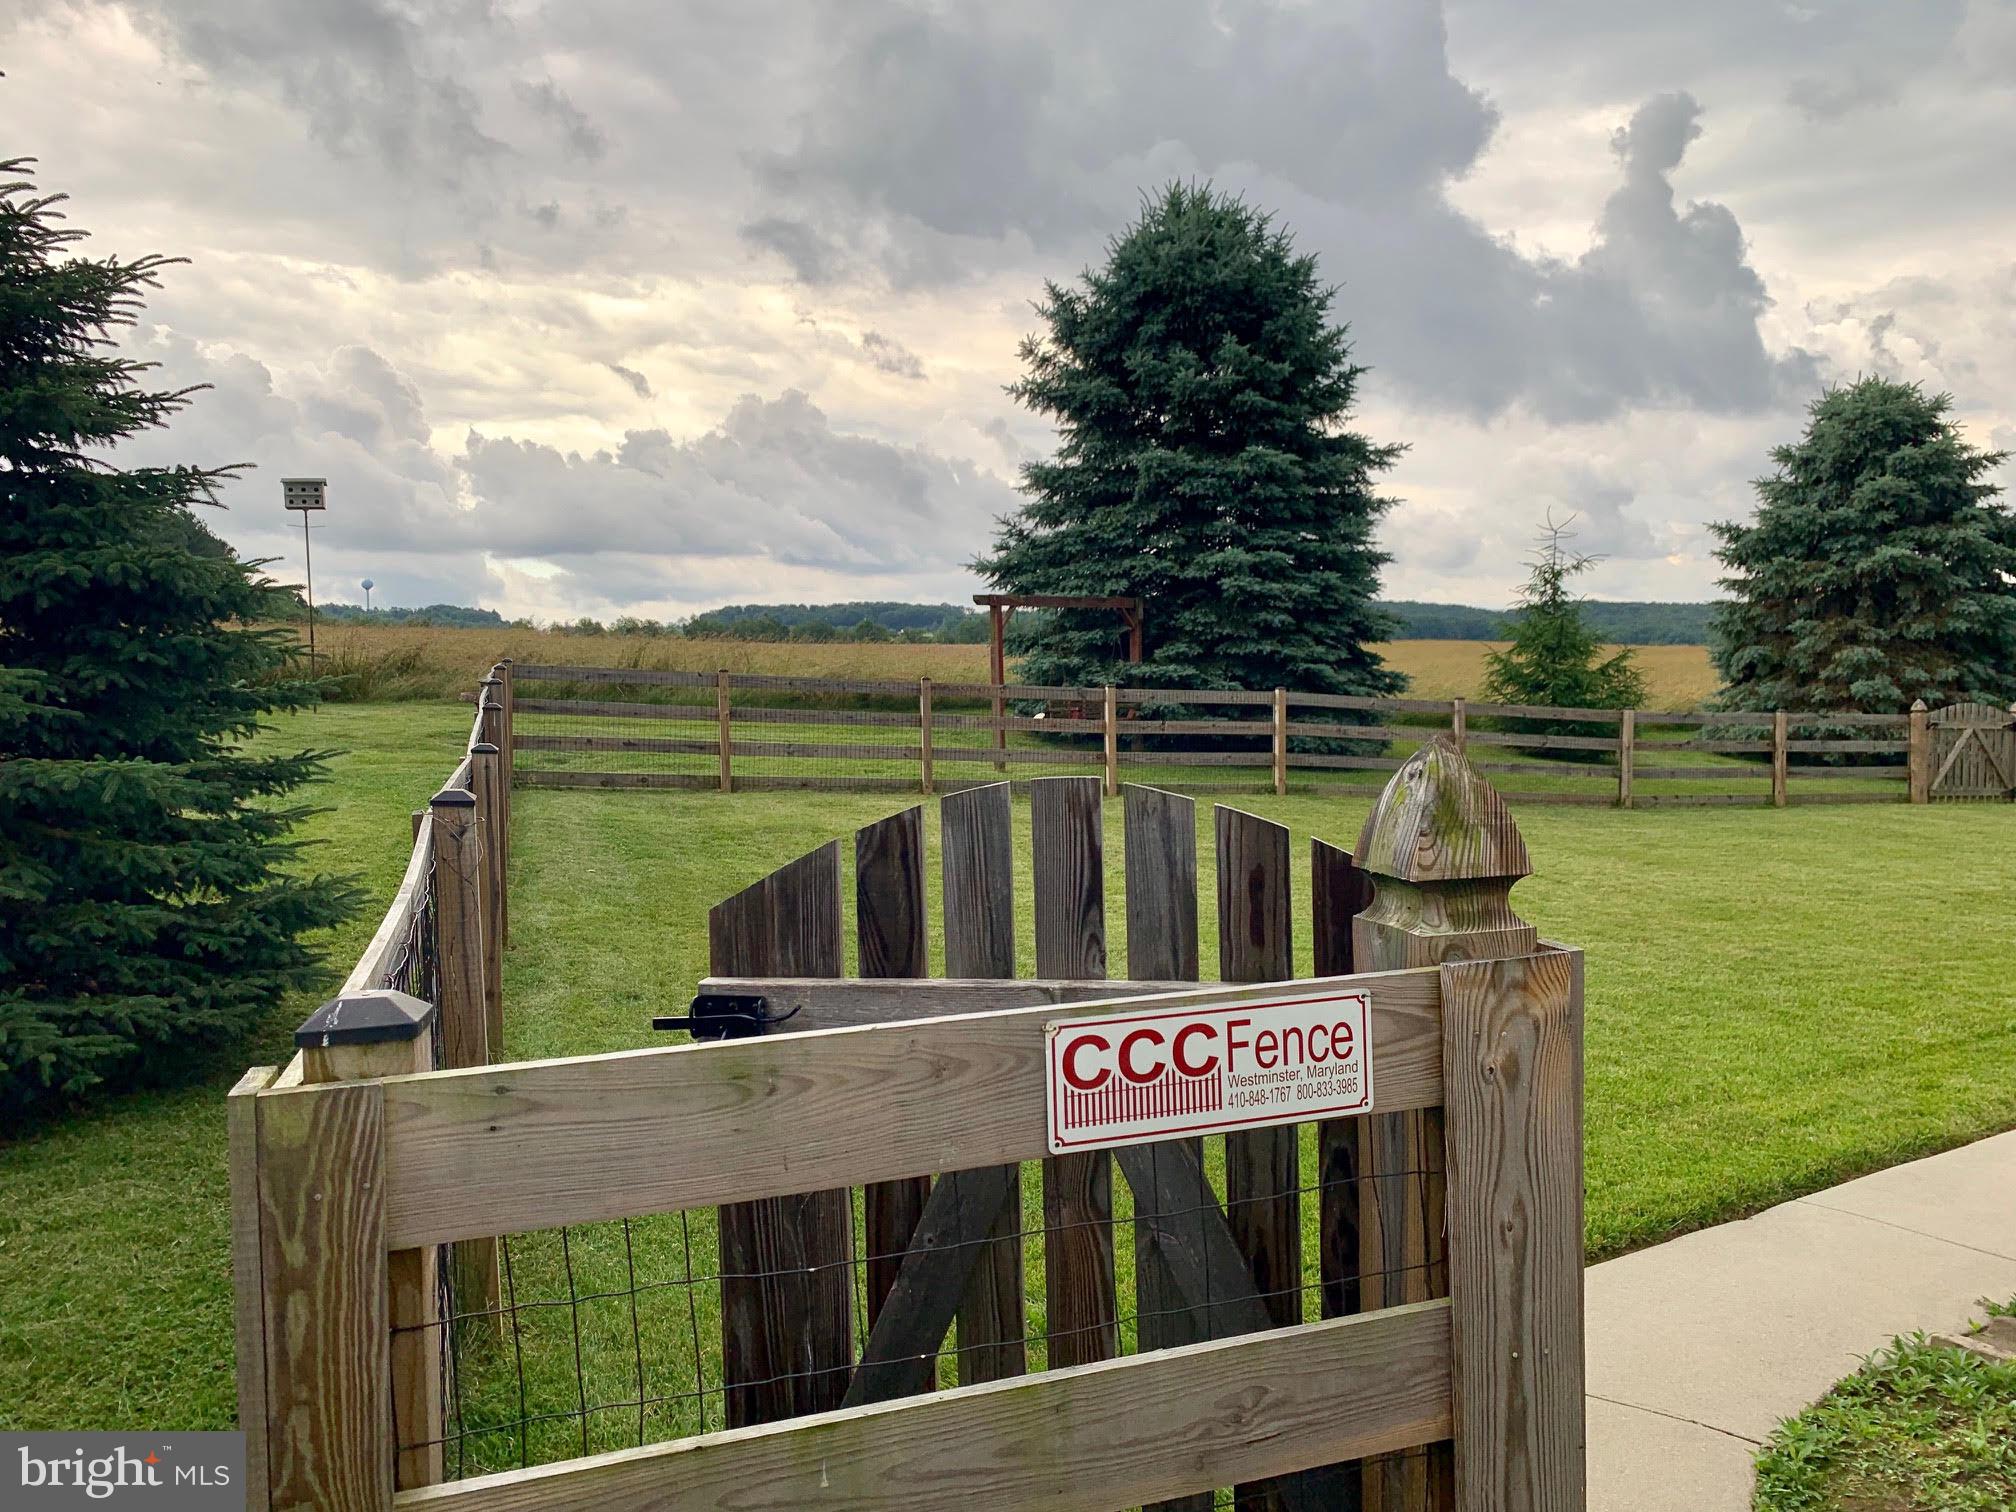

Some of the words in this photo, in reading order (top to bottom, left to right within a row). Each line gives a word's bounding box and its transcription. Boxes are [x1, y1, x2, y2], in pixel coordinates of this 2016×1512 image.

[1062, 1023, 1219, 1090] CCC
[1226, 1018, 1354, 1073] Fence
[1228, 1069, 1303, 1089] Westminster,
[1306, 1059, 1359, 1079] Maryland
[1228, 1085, 1291, 1109] 410-848-1767
[1296, 1077, 1358, 1101] 800-833-3985
